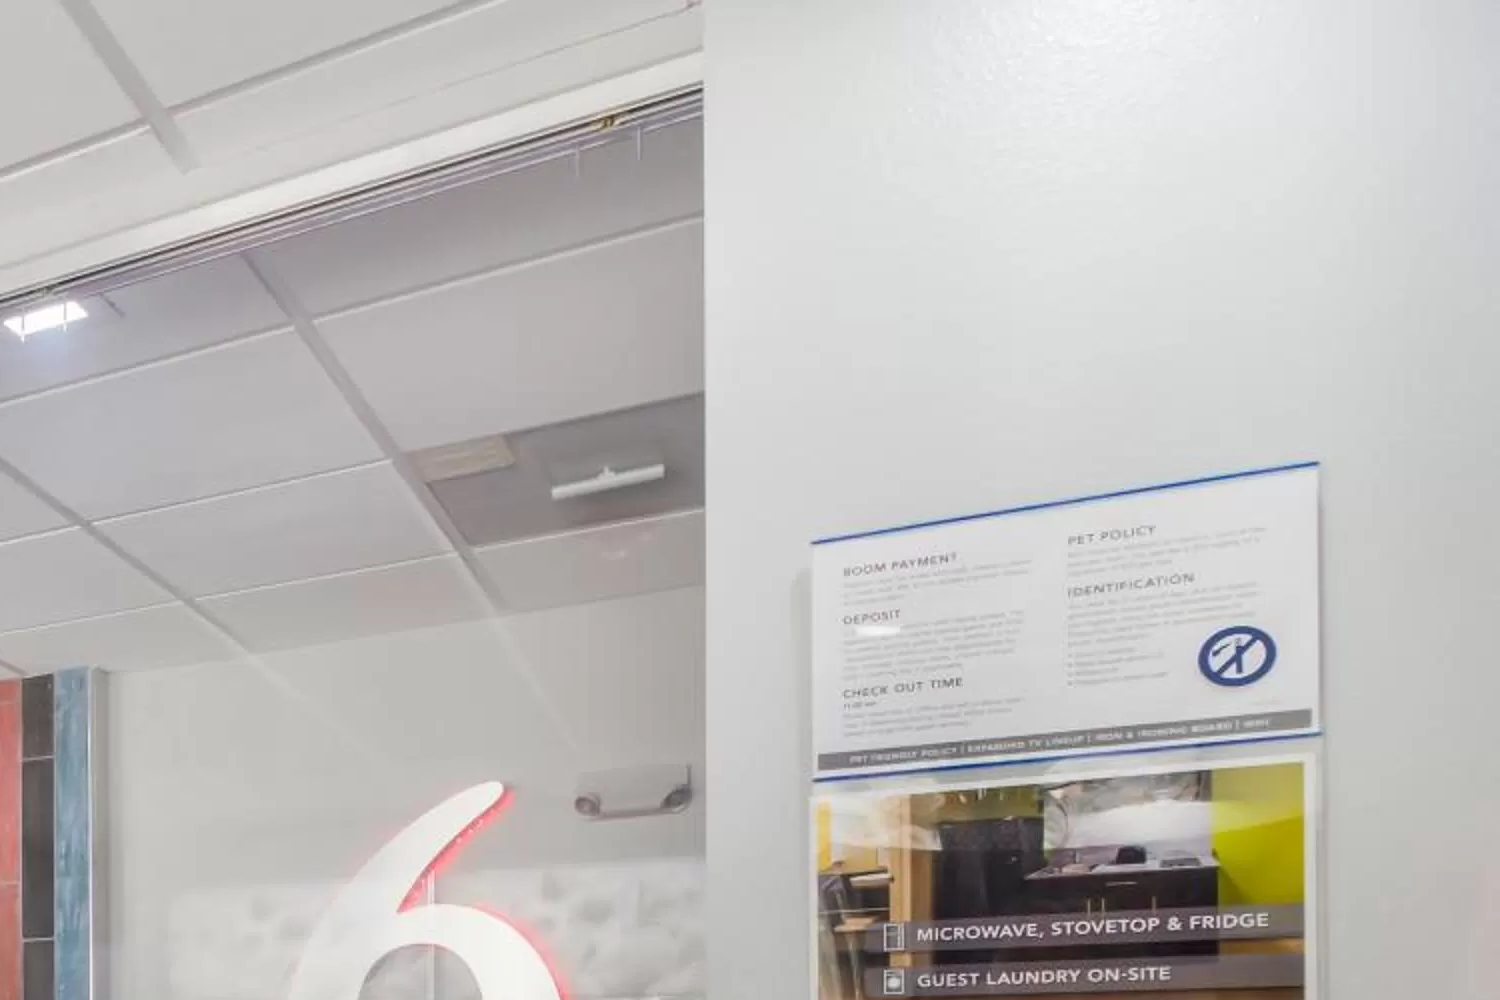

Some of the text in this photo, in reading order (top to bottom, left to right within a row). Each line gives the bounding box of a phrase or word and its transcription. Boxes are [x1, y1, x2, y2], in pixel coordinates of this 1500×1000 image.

[1067, 533, 1094, 546] PET
[1100, 525, 1156, 541] POLICY
[843, 552, 957, 577] ROOM PAYMENT
[1067, 572, 1195, 598] IDENTIFICATION
[843, 609, 901, 625] DEPOSIT
[843, 677, 963, 699] CHECK OUT TIME
[916, 912, 1269, 942] MICROWAVE, STOVETOP & FRIDGE
[916, 965, 1172, 988] GUEST LAUNDRY ON-SITE
